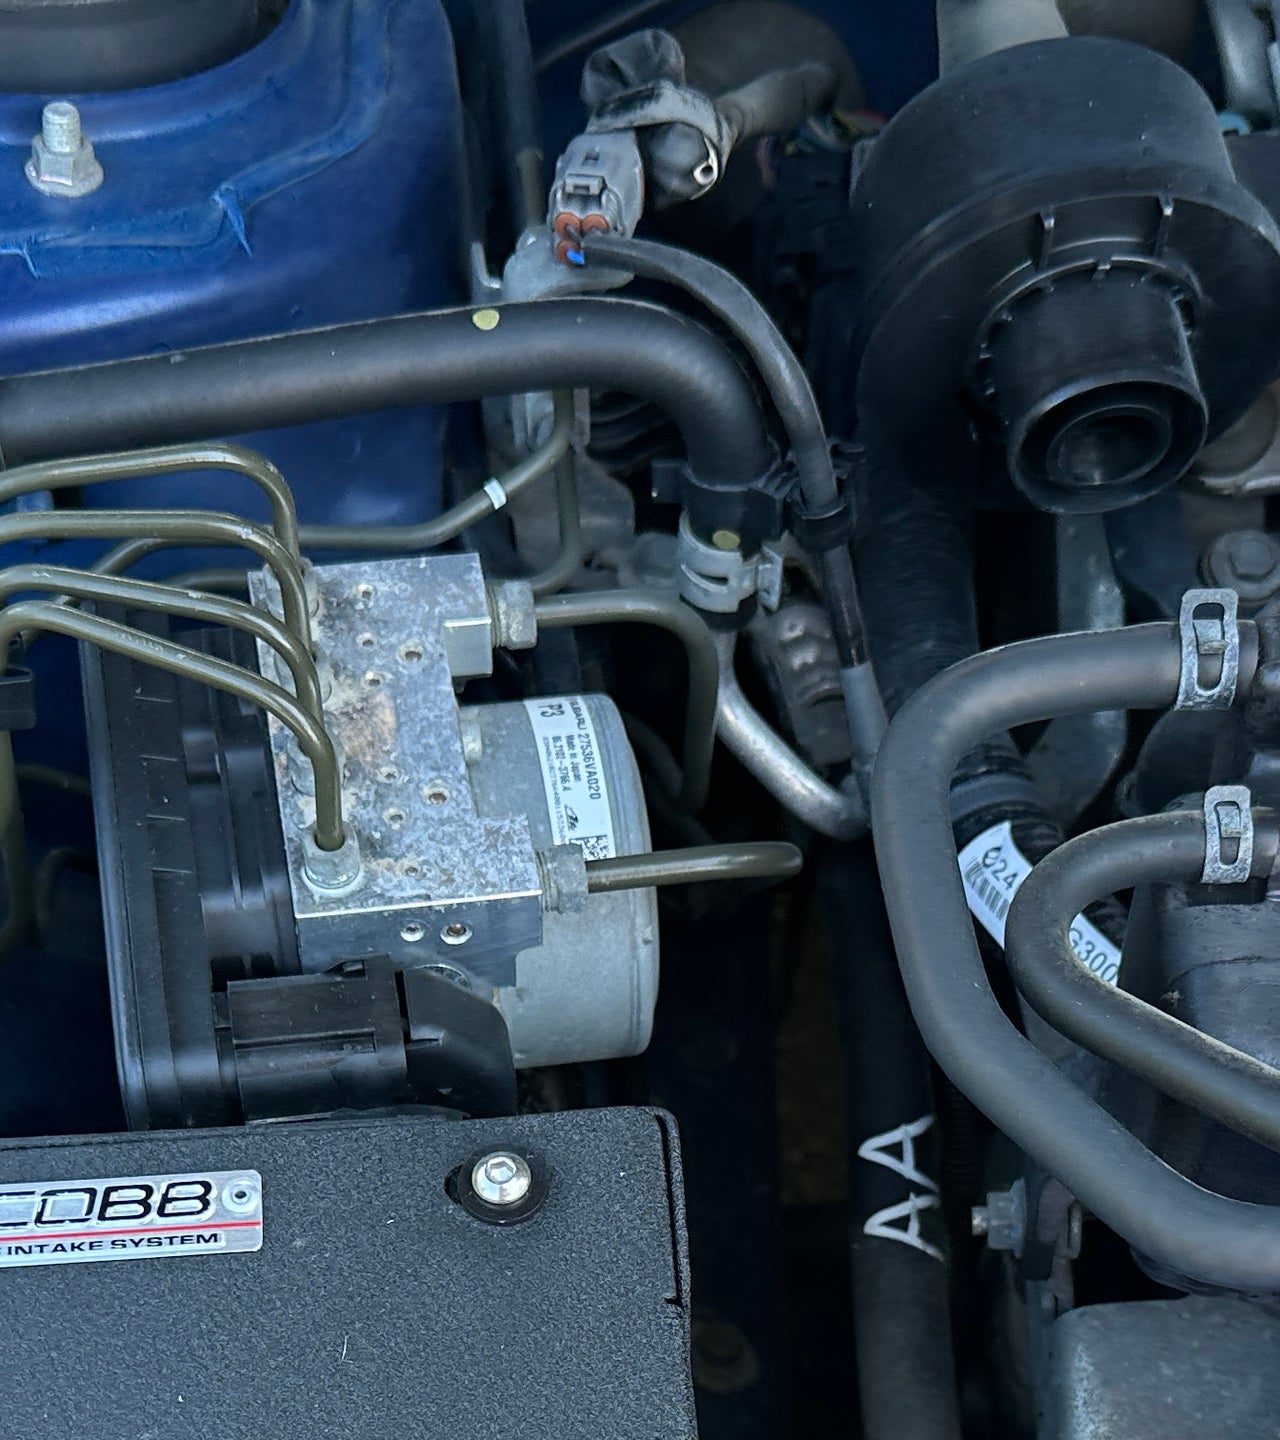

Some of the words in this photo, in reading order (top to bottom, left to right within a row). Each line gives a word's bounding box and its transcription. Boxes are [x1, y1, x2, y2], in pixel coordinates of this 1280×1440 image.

[538, 703, 565, 718] P3
[578, 733, 601, 800] 27536VA020
[7, 1240, 104, 1256] INTAKE
[110, 1232, 219, 1250] SYSTEM
